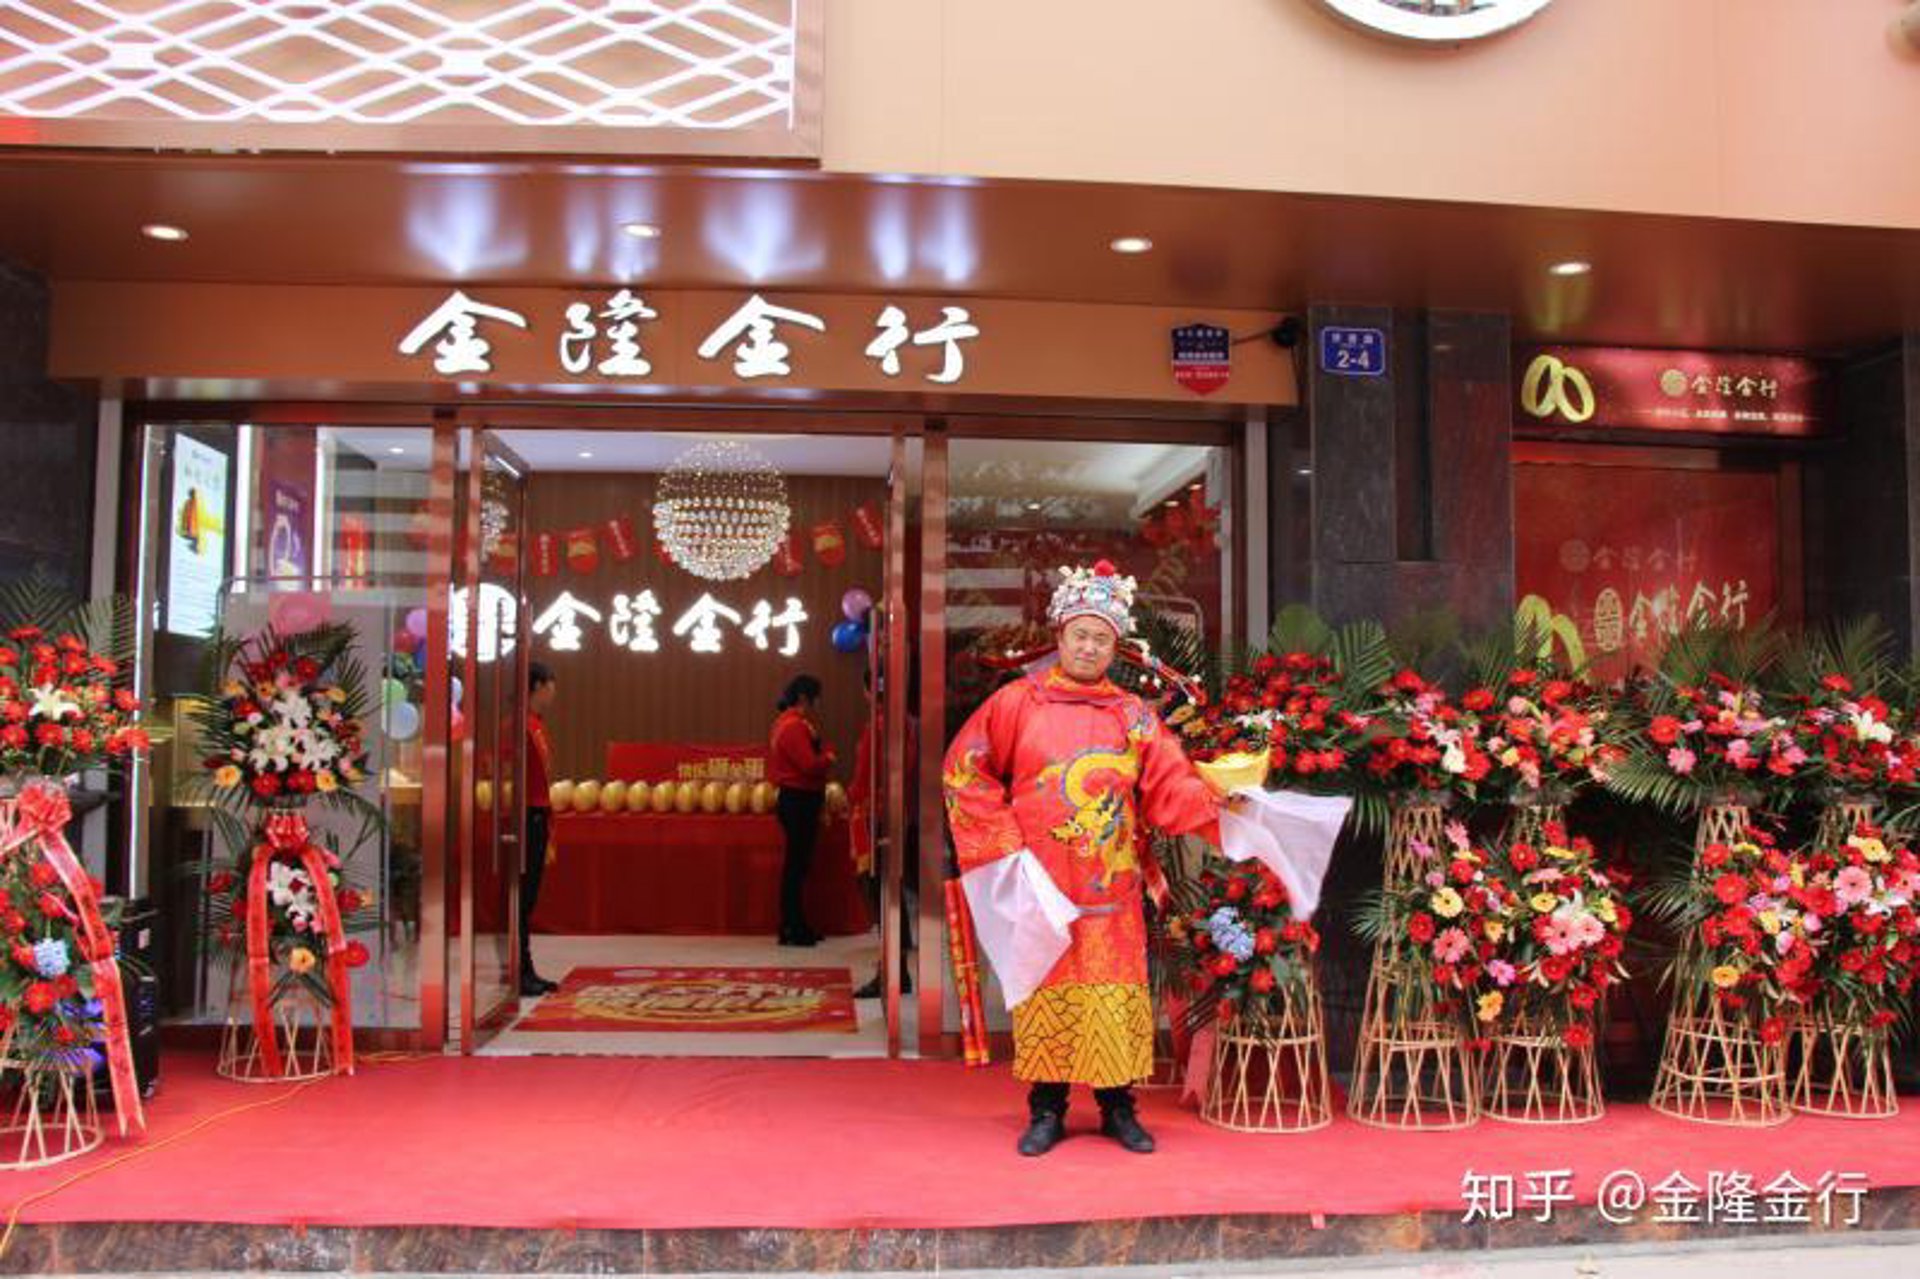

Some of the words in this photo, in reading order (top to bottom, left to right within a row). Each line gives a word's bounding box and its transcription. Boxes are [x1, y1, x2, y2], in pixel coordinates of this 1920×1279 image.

[399, 289, 980, 384] 金隆金行
[1337, 349, 1369, 369] 2-4
[532, 588, 809, 658] 金隆金行
